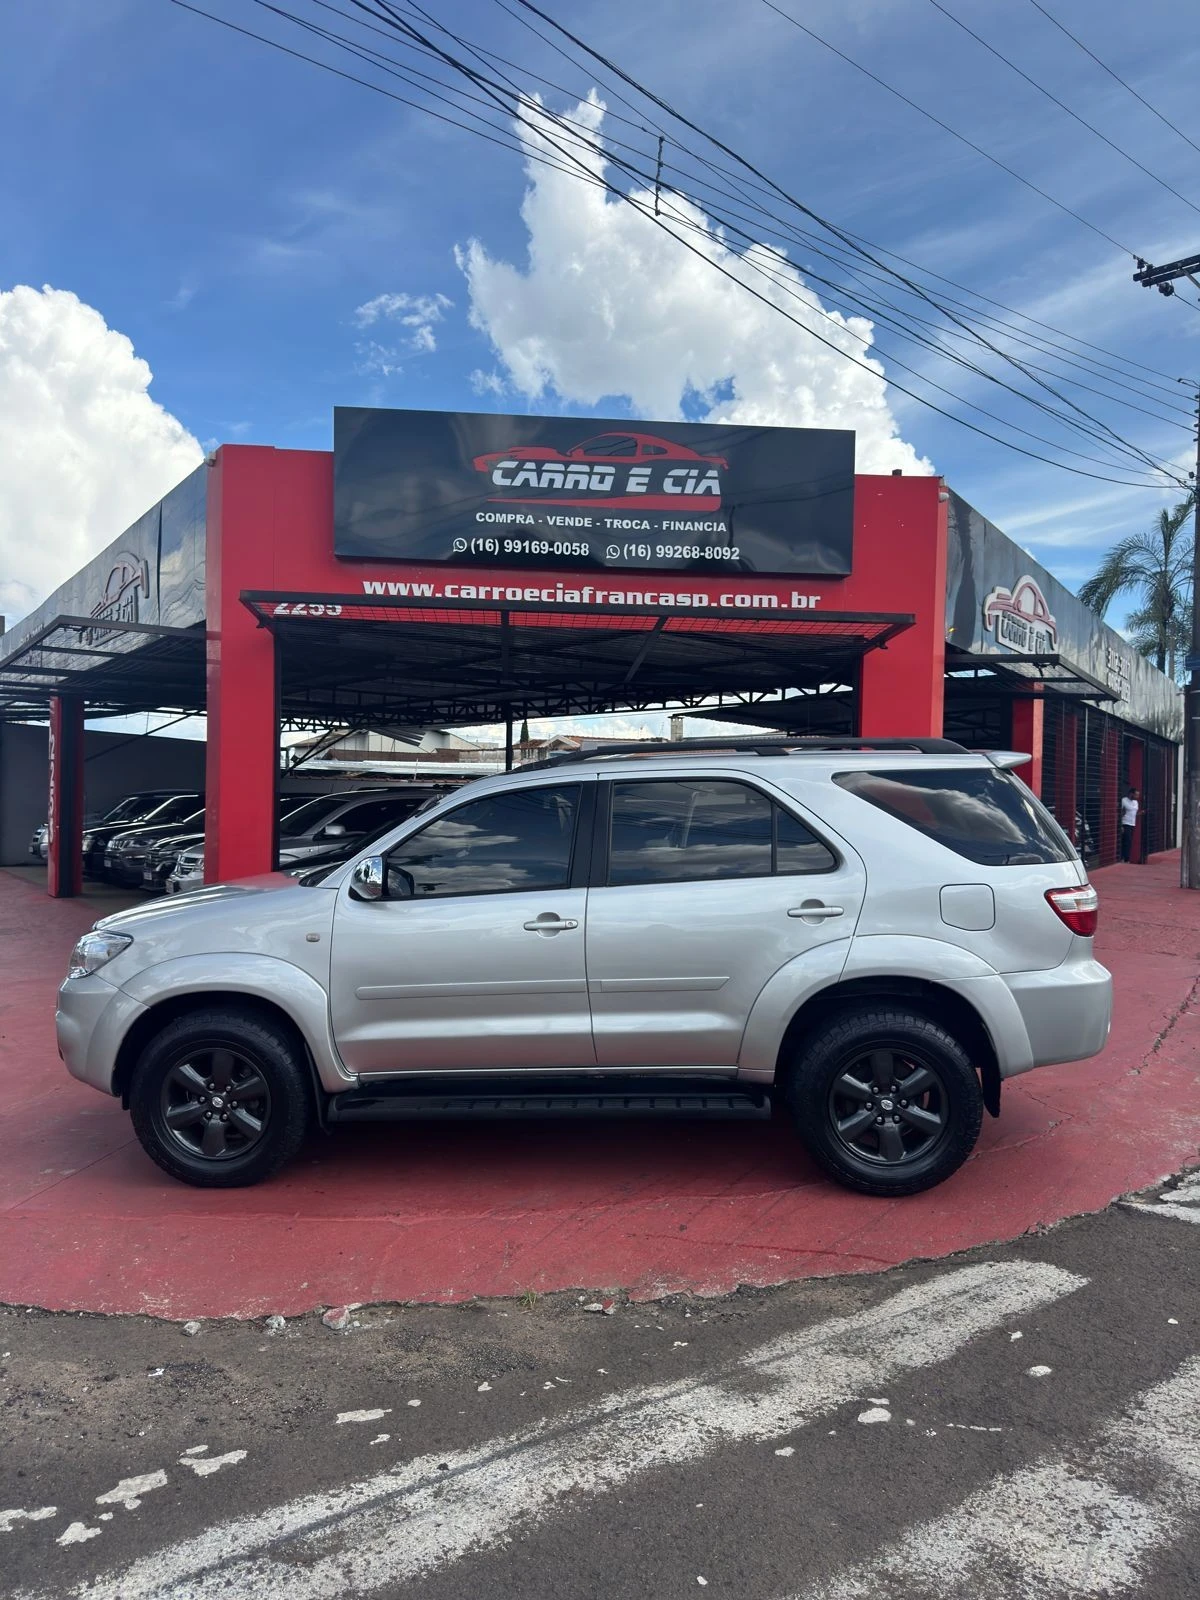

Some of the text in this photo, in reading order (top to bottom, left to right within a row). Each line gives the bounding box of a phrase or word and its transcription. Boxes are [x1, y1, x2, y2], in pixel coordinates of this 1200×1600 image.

[492, 460, 721, 495] CARRO E CIA
[475, 512, 727, 532] COMPRA VENDE TROCA FINANCIA
[470, 537, 590, 556] (16) 99169-0058
[623, 543, 740, 561] (16) 99268-8092
[362, 580, 821, 609] www.carroeciafrancasp.com.br
